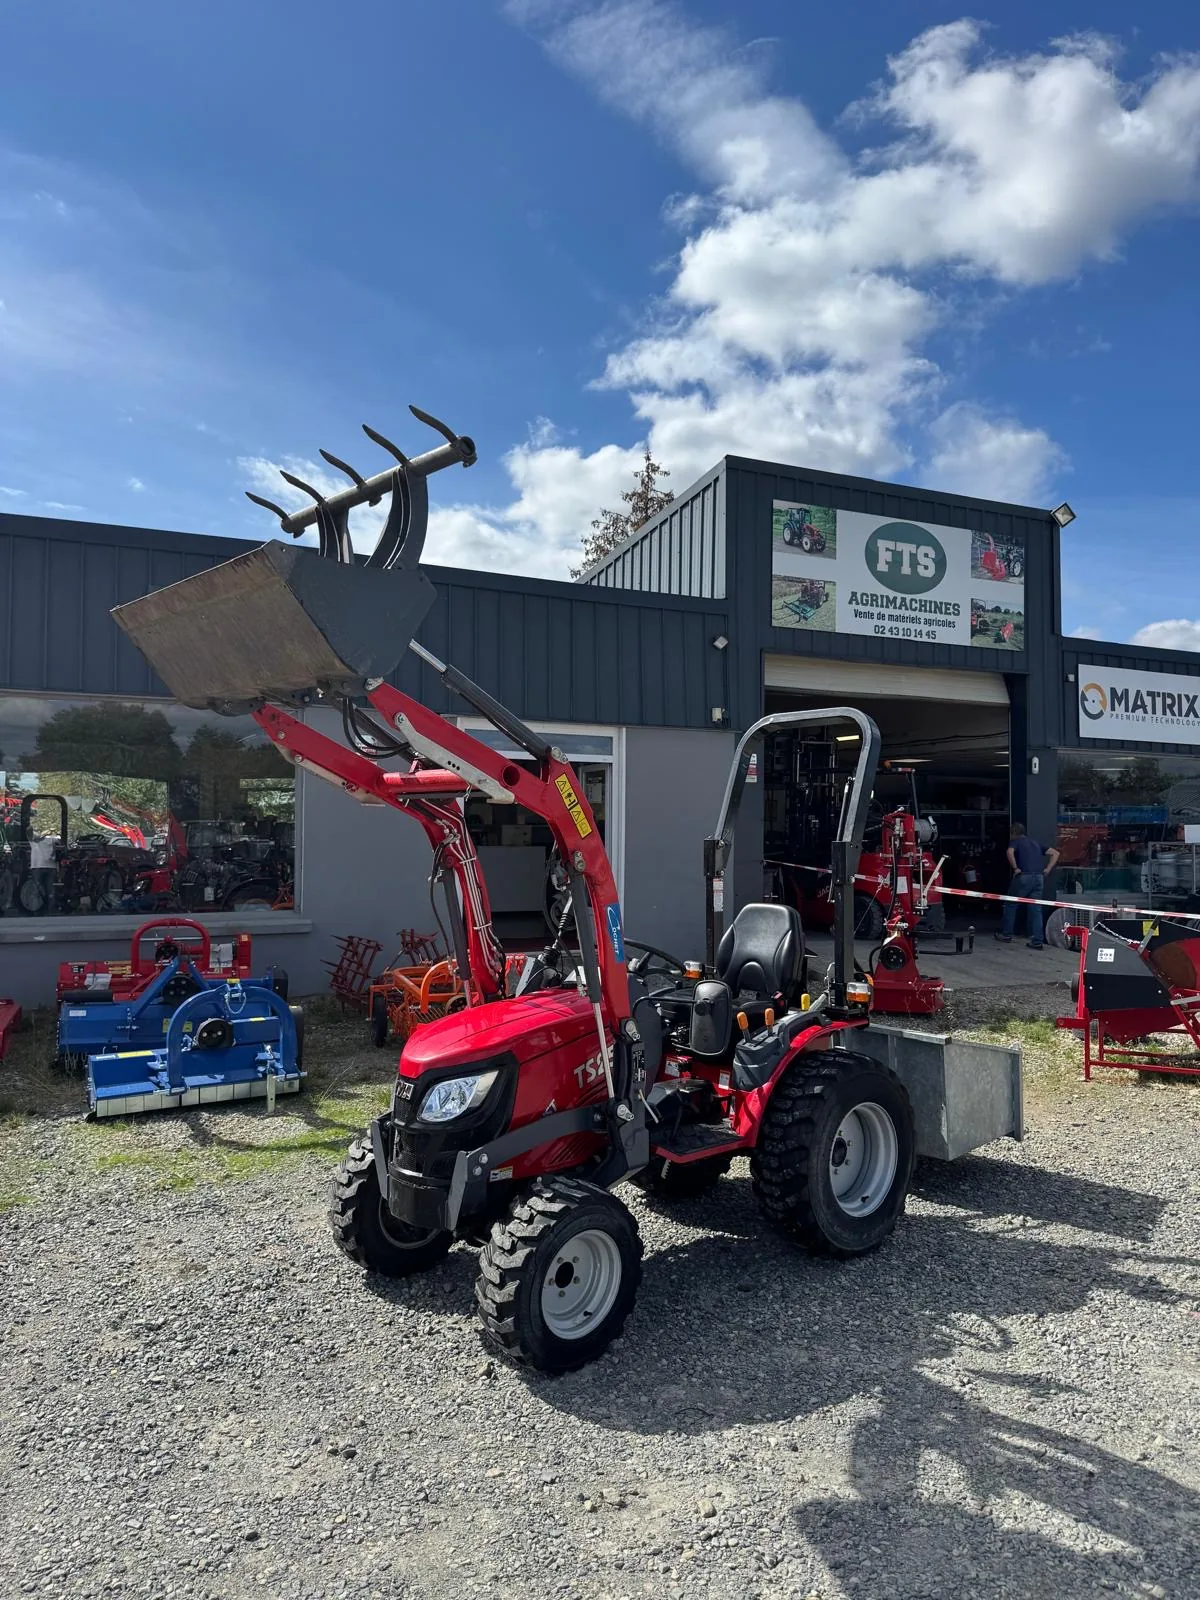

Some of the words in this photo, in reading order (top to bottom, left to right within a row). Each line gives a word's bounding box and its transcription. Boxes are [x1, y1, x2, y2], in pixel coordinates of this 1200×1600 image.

[877, 539, 936, 578] FTS
[848, 591, 961, 616] AGRIMACHINES
[853, 608, 875, 620] Vente
[876, 611, 886, 621] de
[887, 612, 922, 625] matériels
[923, 616, 956, 629] agricoles
[874, 624, 886, 635] 02
[888, 625, 900, 636] 43
[901, 627, 912, 638] 10
[914, 628, 924, 639] 14
[925, 630, 937, 640] 45
[1109, 686, 1200, 719] MATRIX
[1110, 712, 1147, 722] PREMIUM
[1150, 716, 1200, 727] TECHNOLOGY
